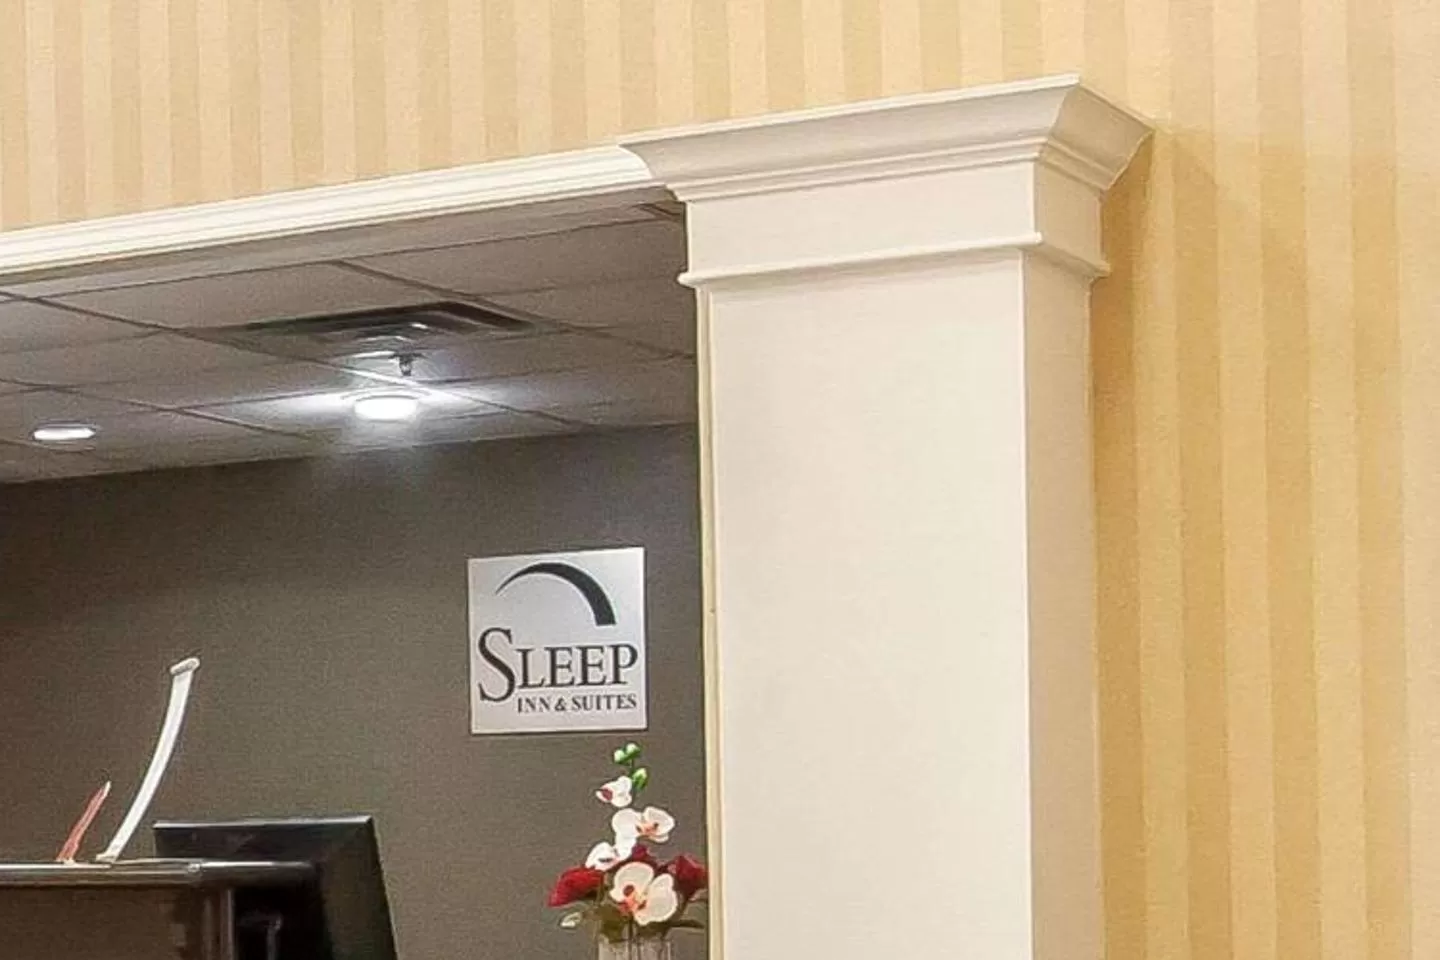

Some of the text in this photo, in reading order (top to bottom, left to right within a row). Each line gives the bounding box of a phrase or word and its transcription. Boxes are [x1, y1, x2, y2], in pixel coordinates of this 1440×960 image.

[478, 627, 638, 702] SLEEP
[518, 694, 637, 713] INN & SUITES
